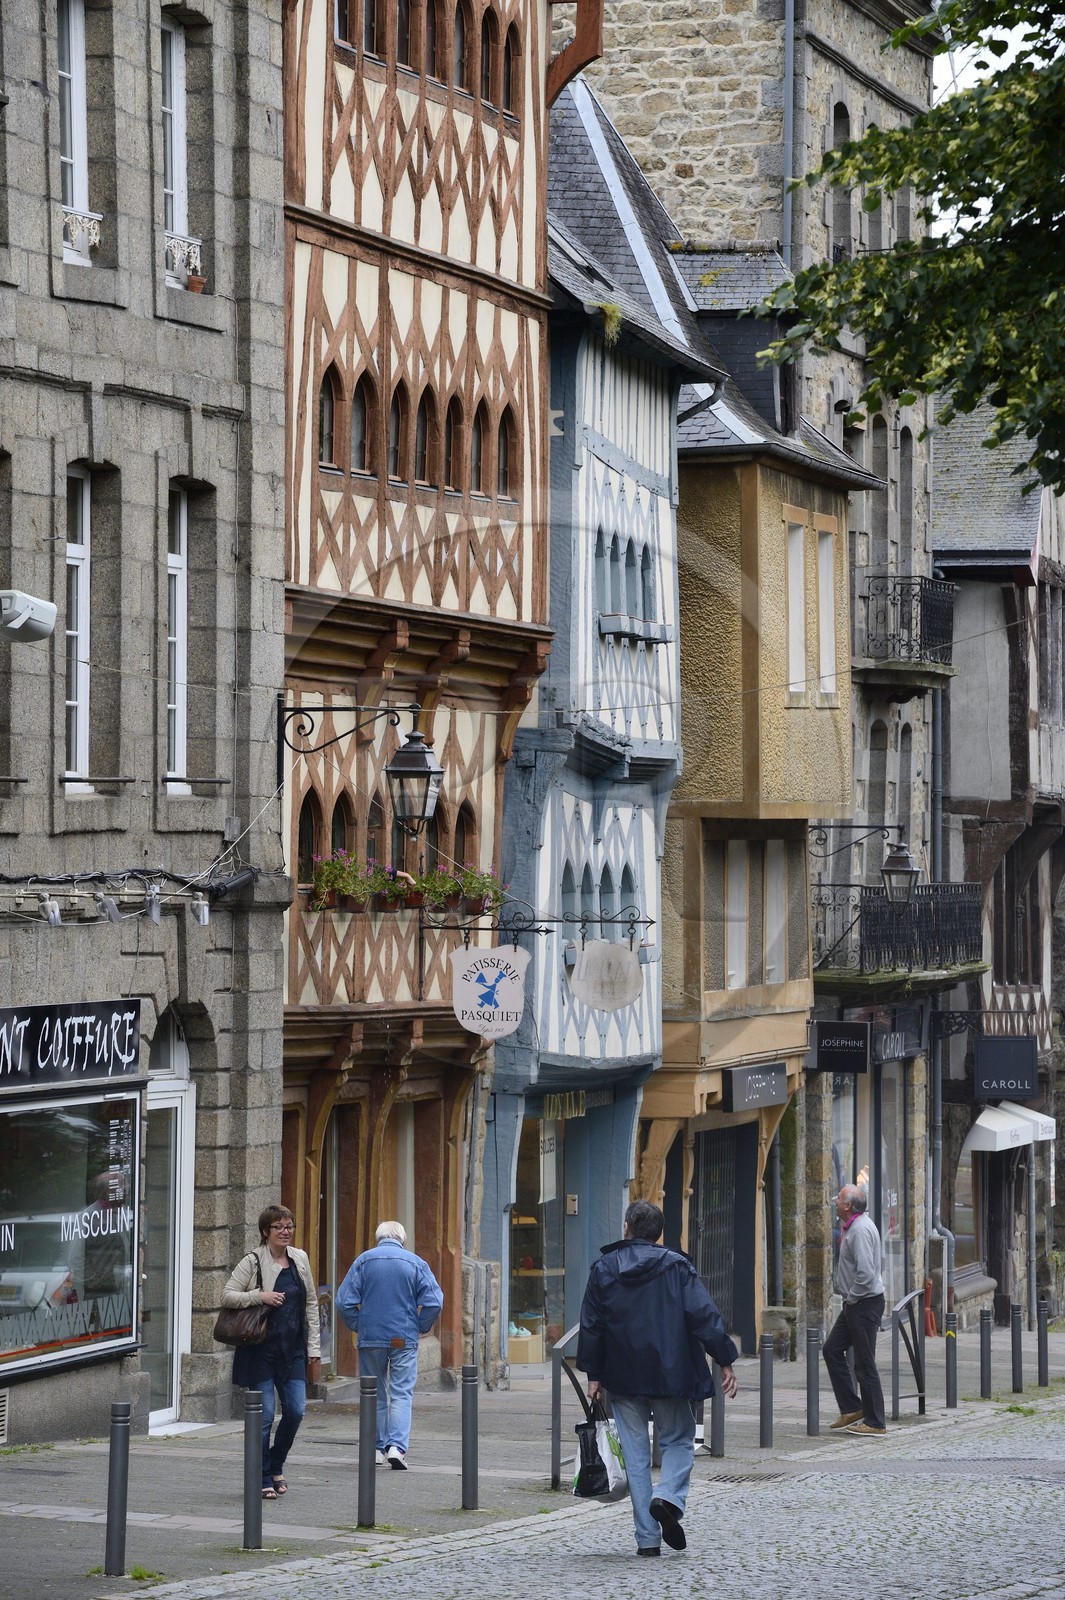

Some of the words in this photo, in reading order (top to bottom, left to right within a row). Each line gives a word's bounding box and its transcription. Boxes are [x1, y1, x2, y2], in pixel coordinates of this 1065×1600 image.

[461, 957, 521, 985] PATISSERIE
[461, 1009, 521, 1023] PASQUIET
[37, 1010, 136, 1077] COIFFURE
[820, 1039, 865, 1048] JOSEPHINE
[881, 1031, 906, 1060] CAROLL
[982, 1080, 1031, 1089] CAROLL
[887, 1188, 898, 1208] Sldes
[60, 1205, 131, 1242] MASCULIN
